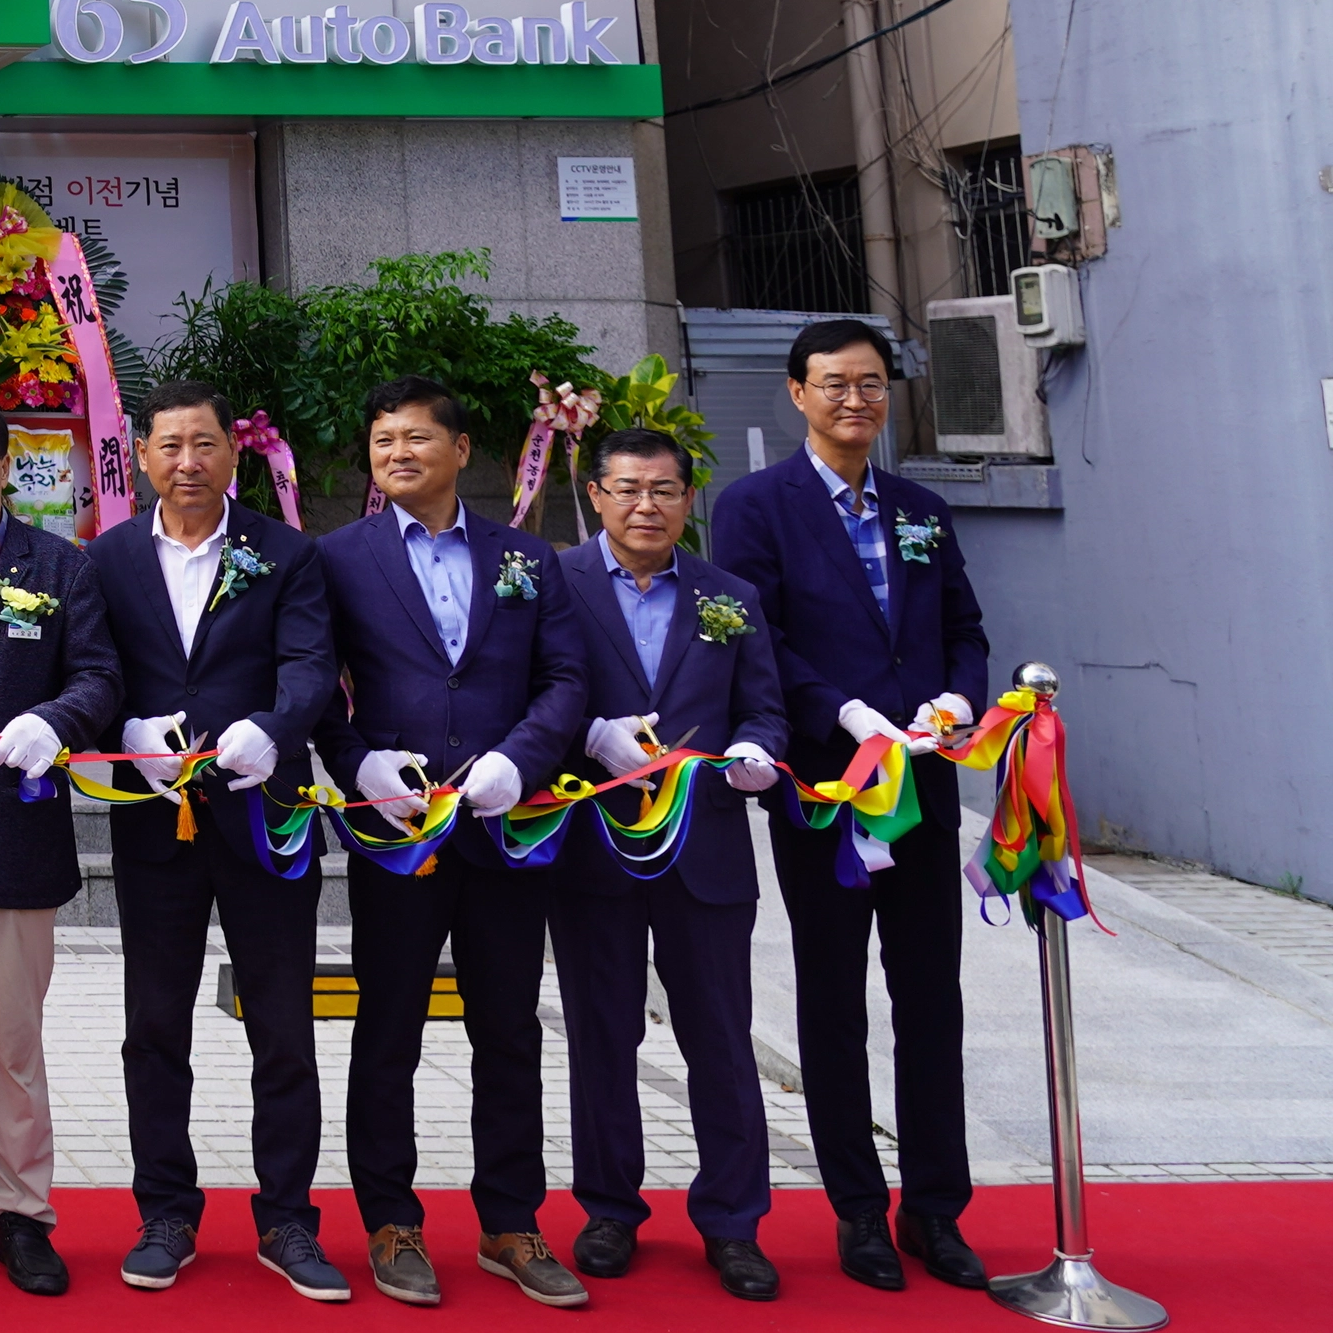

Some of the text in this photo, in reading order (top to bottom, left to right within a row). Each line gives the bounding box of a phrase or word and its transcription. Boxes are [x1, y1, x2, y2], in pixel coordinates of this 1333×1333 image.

[212, 0, 411, 65] Auto
[414, 0, 620, 66] Bank
[66, 175, 180, 209] 이전기념
